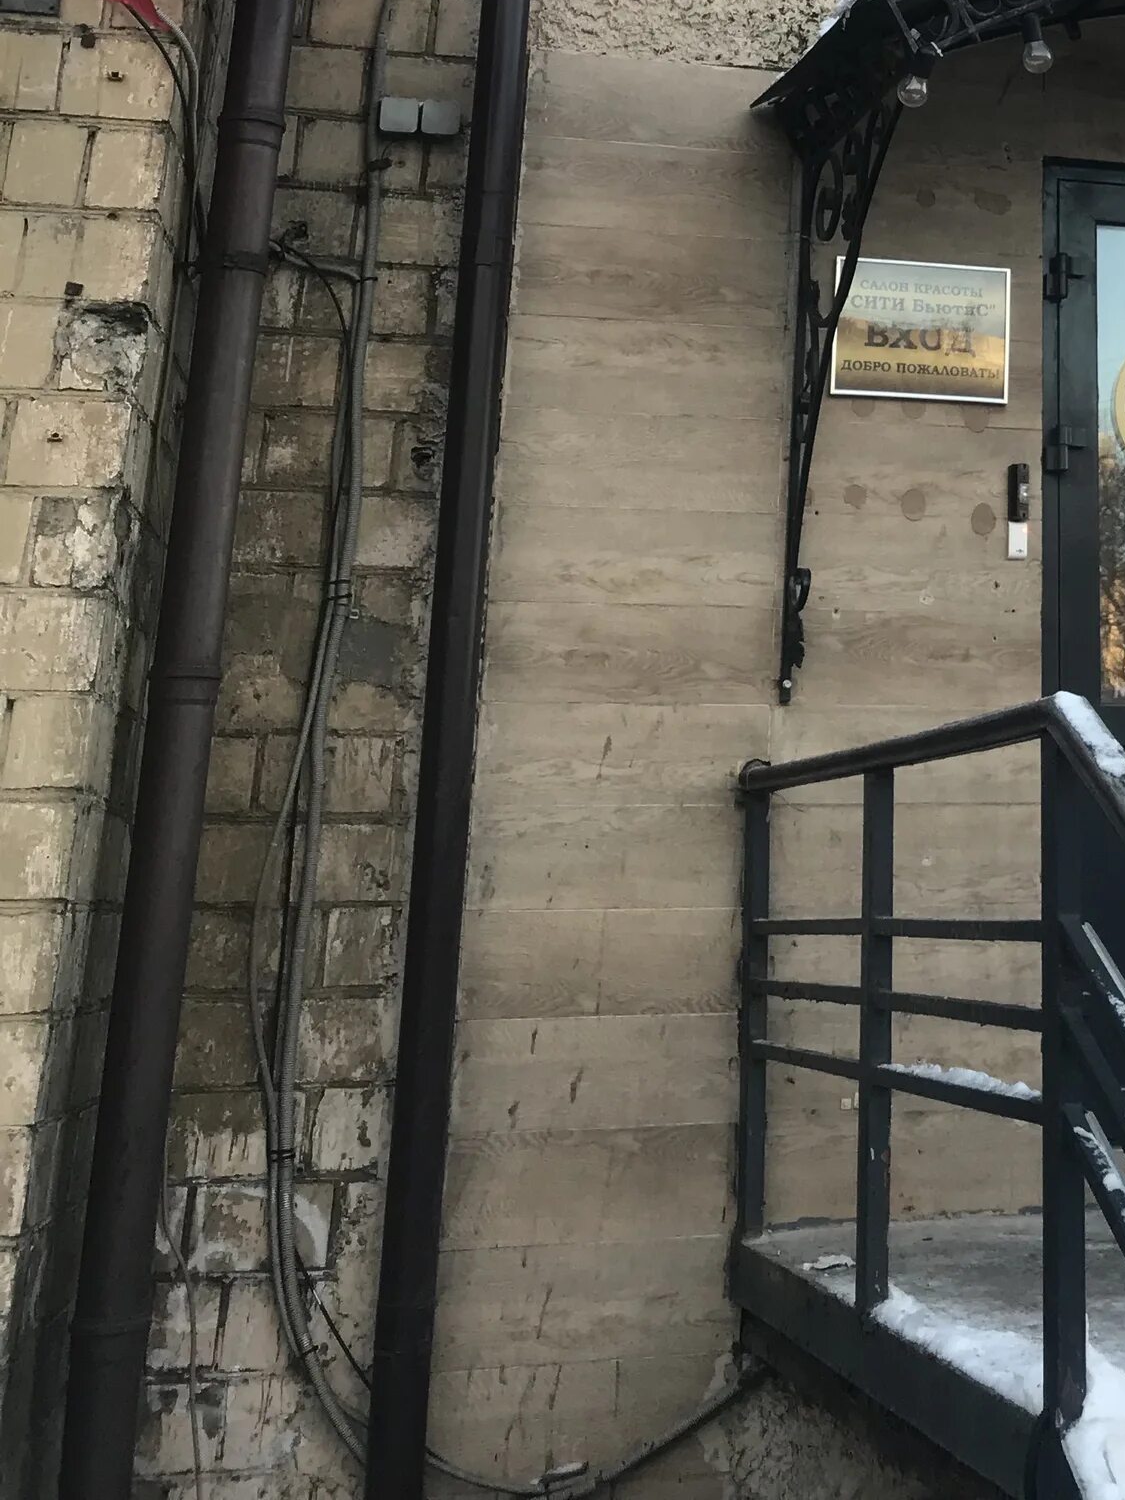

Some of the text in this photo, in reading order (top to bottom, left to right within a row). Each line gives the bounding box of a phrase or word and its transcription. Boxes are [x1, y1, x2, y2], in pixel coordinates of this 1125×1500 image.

[860, 279, 983, 298] САЛОН КРАСОТЫ
[840, 359, 1000, 379] ДОБРО ПОЖАЛОВАТЬ!
